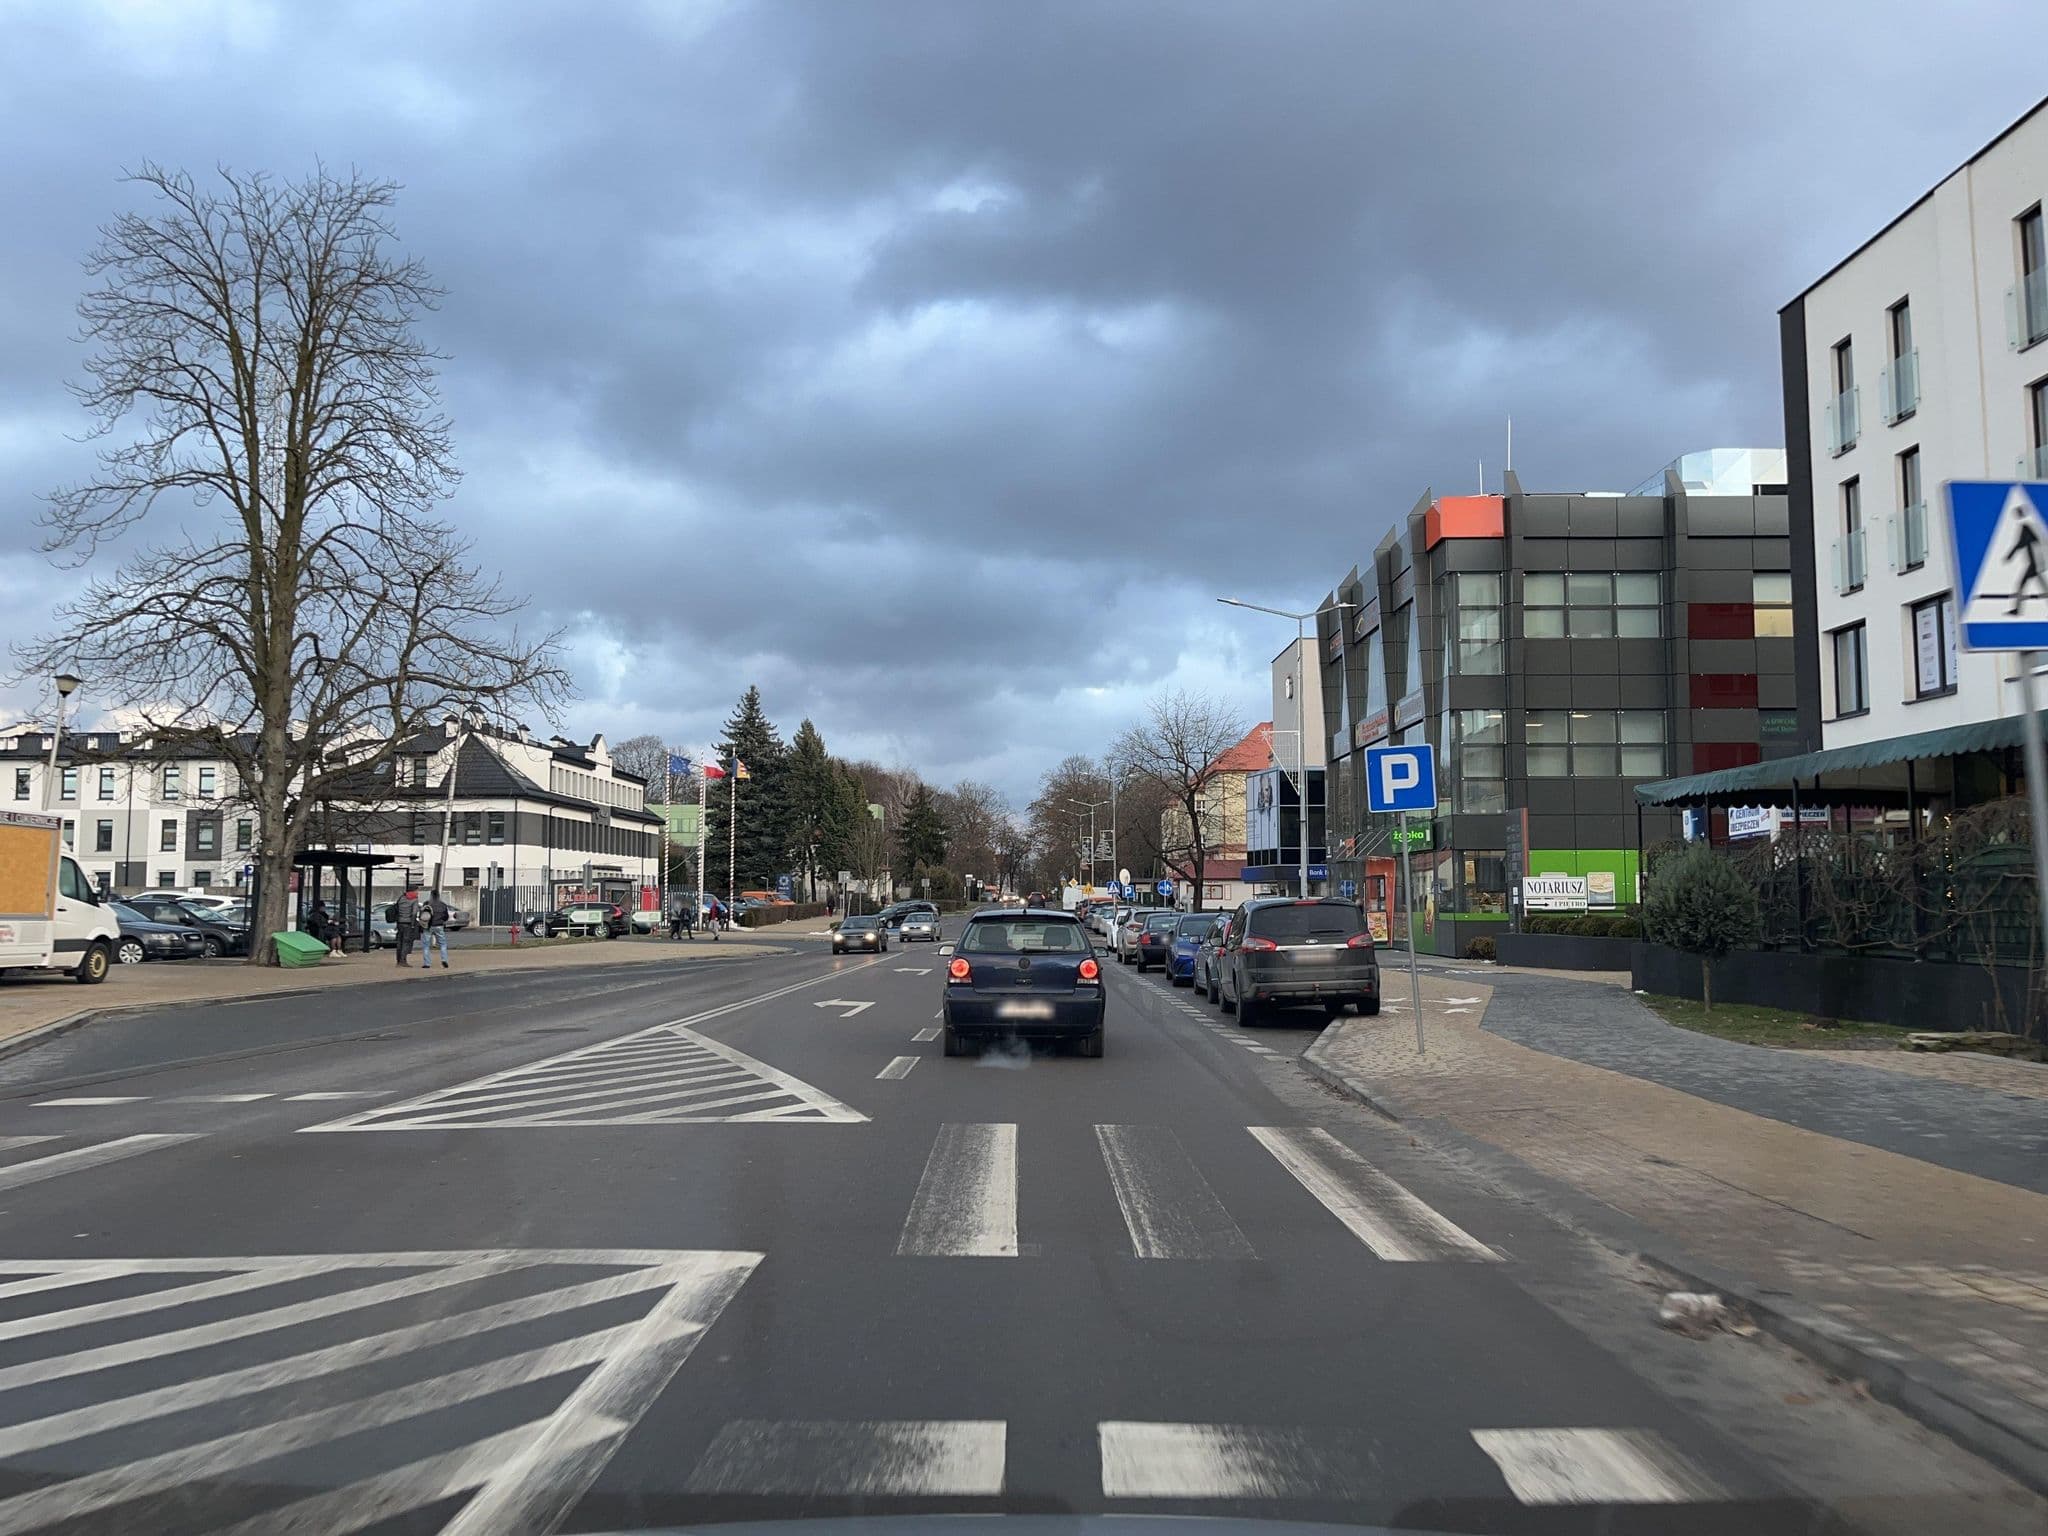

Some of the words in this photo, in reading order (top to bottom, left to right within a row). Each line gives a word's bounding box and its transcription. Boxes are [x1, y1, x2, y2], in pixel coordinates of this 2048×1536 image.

[1381, 753, 1420, 804] P
[1124, 886, 1132, 896] P
[1527, 881, 1584, 894] NOTARIUSZ
